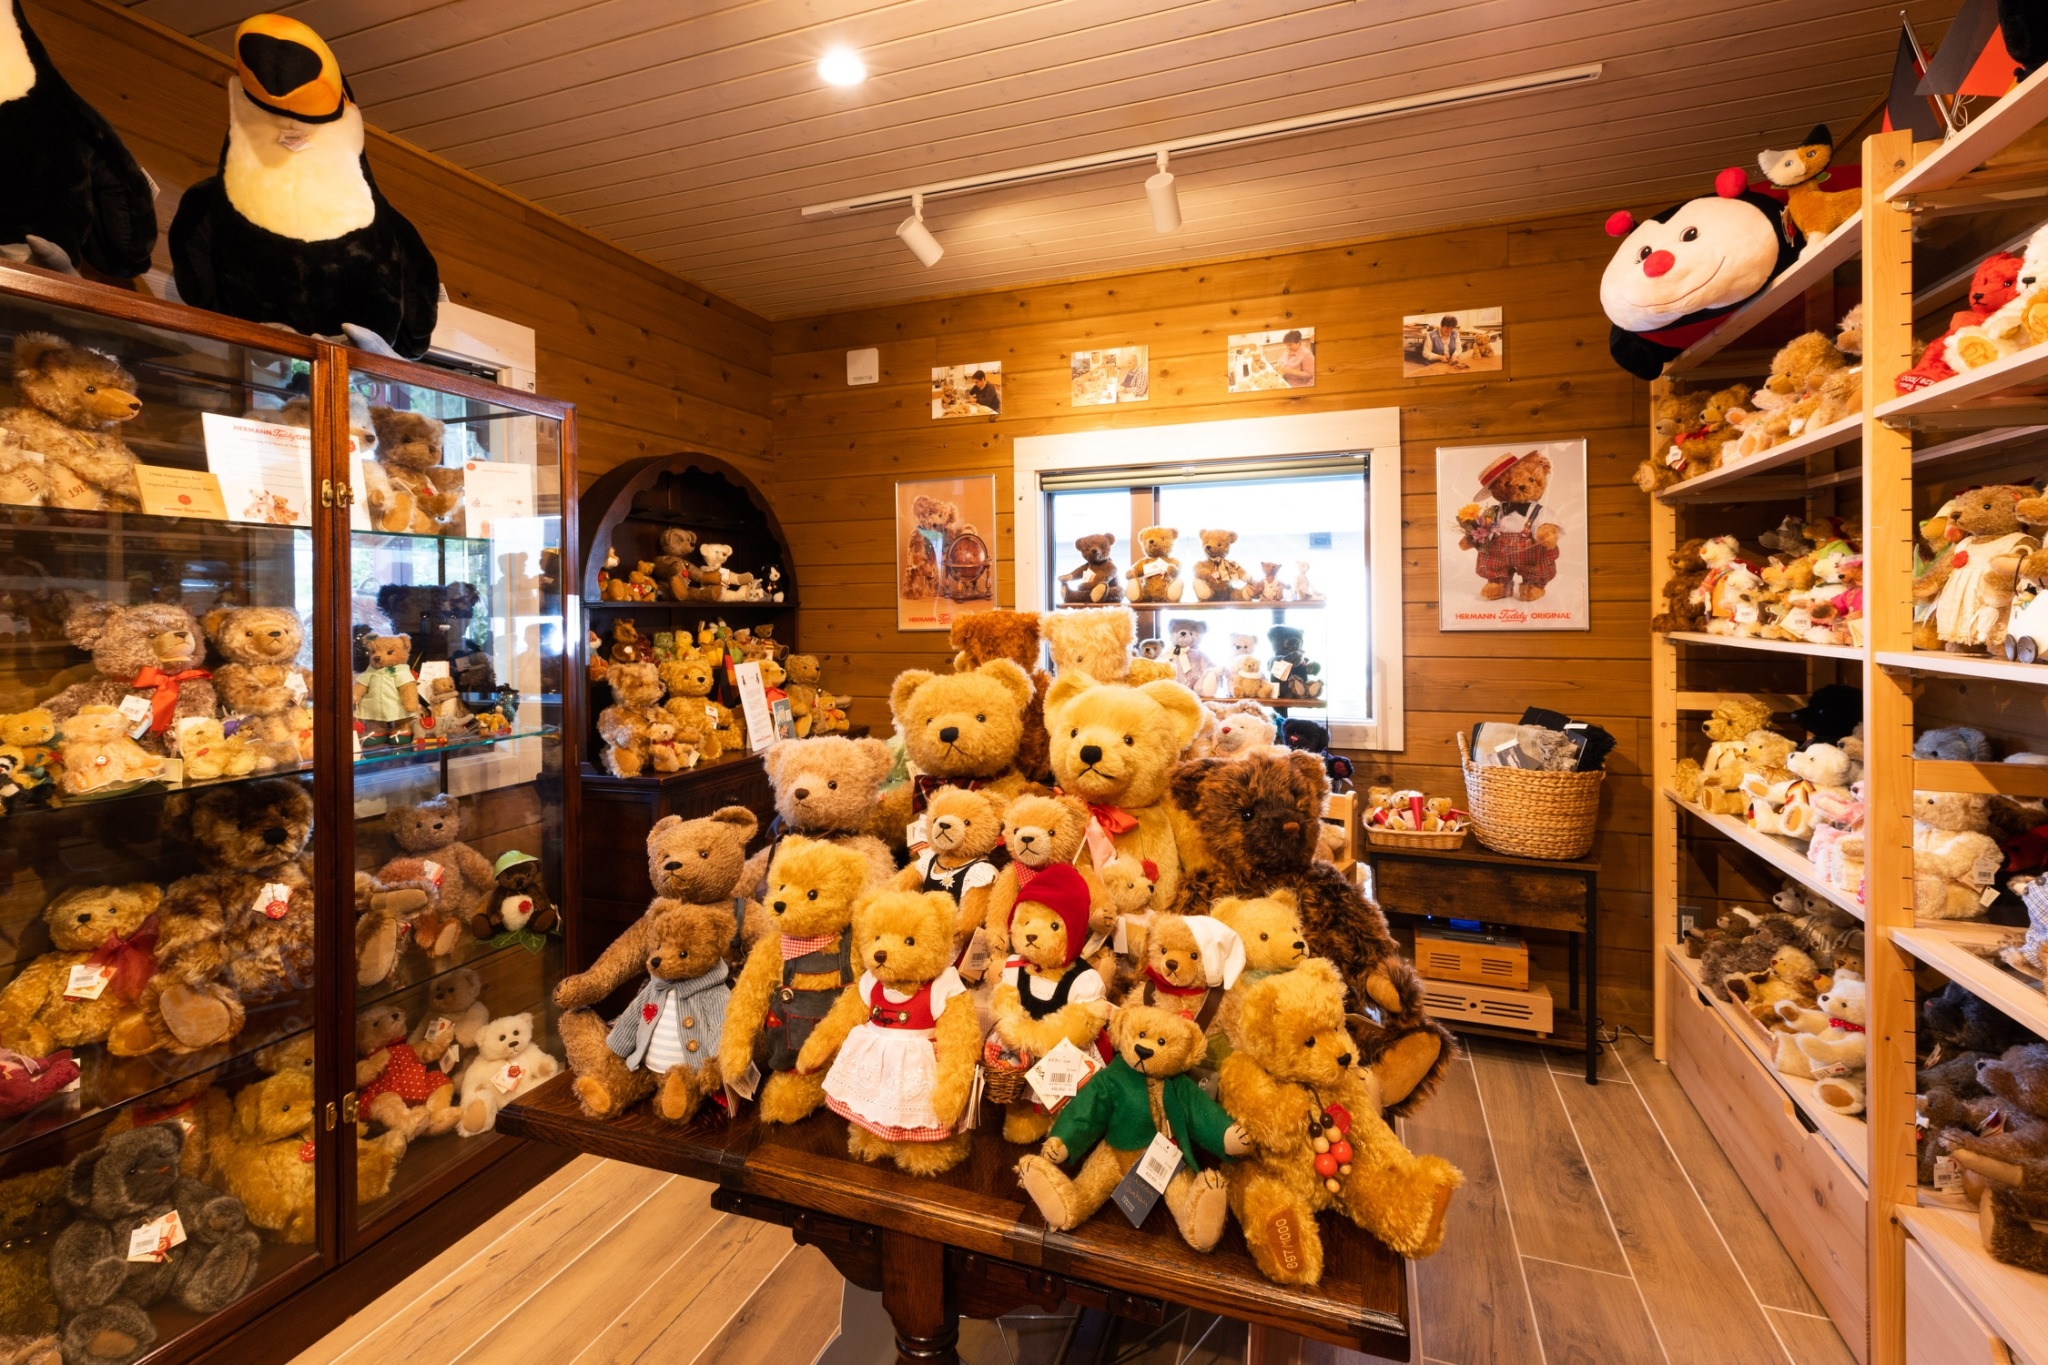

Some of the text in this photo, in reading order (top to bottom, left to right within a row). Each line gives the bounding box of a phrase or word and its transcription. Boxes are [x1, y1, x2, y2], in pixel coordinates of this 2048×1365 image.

[233, 425, 272, 436] HERMANN
[273, 428, 296, 442] Teddy
[1499, 609, 1527, 623] Teddy
